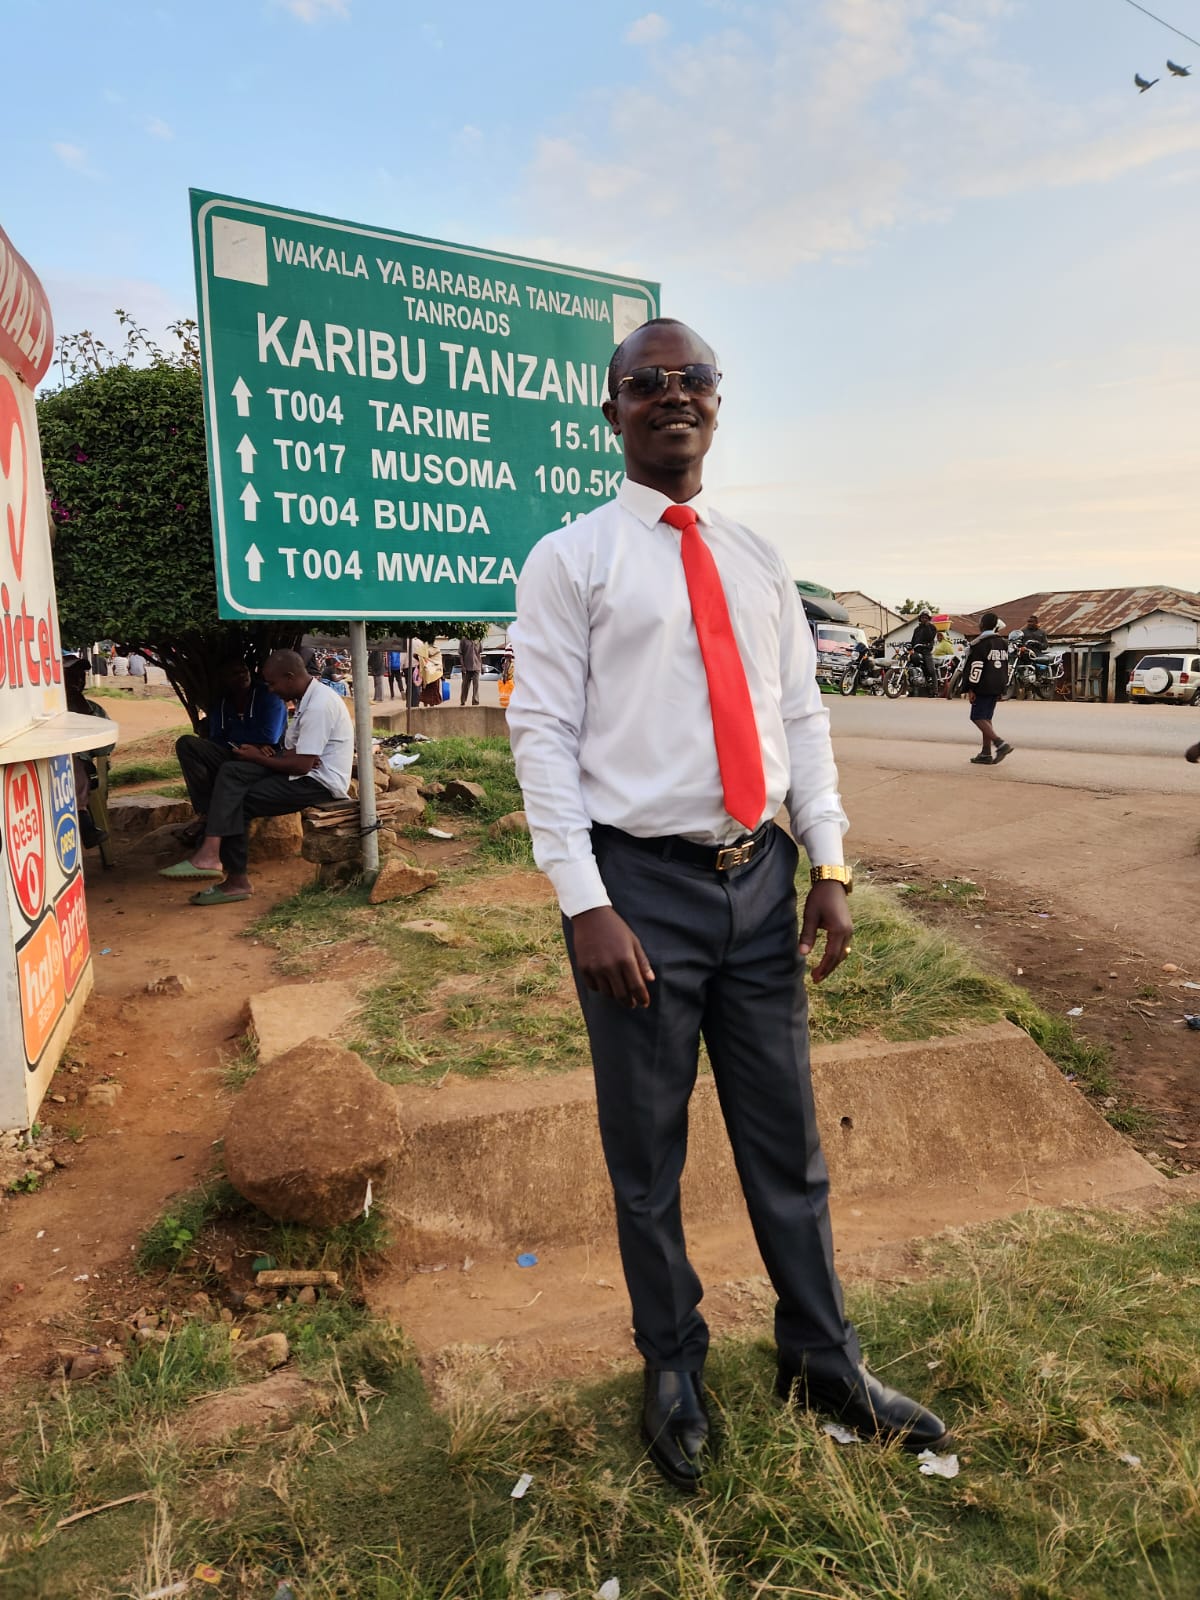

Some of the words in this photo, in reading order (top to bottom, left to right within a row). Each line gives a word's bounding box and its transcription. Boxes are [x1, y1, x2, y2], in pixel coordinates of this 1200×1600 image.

[271, 236, 369, 280] WAKALA
[375, 258, 407, 287] YA
[411, 265, 521, 307] BARABARA
[525, 285, 612, 323] TANZANIA
[403, 296, 511, 337] TANROADS
[257, 312, 427, 385] KARIBU
[266, 387, 344, 426] T004
[368, 399, 491, 443] TARIME
[273, 438, 346, 474] T017
[371, 448, 517, 491] MUSOMA
[534, 464, 627, 497] 100.5K
[273, 491, 360, 527] T004
[374, 499, 491, 535] BUNDA
[278, 547, 363, 582] T004
[377, 551, 518, 585] MWANZA
[12, 773, 29, 814] M
[11, 809, 39, 868] pesa
